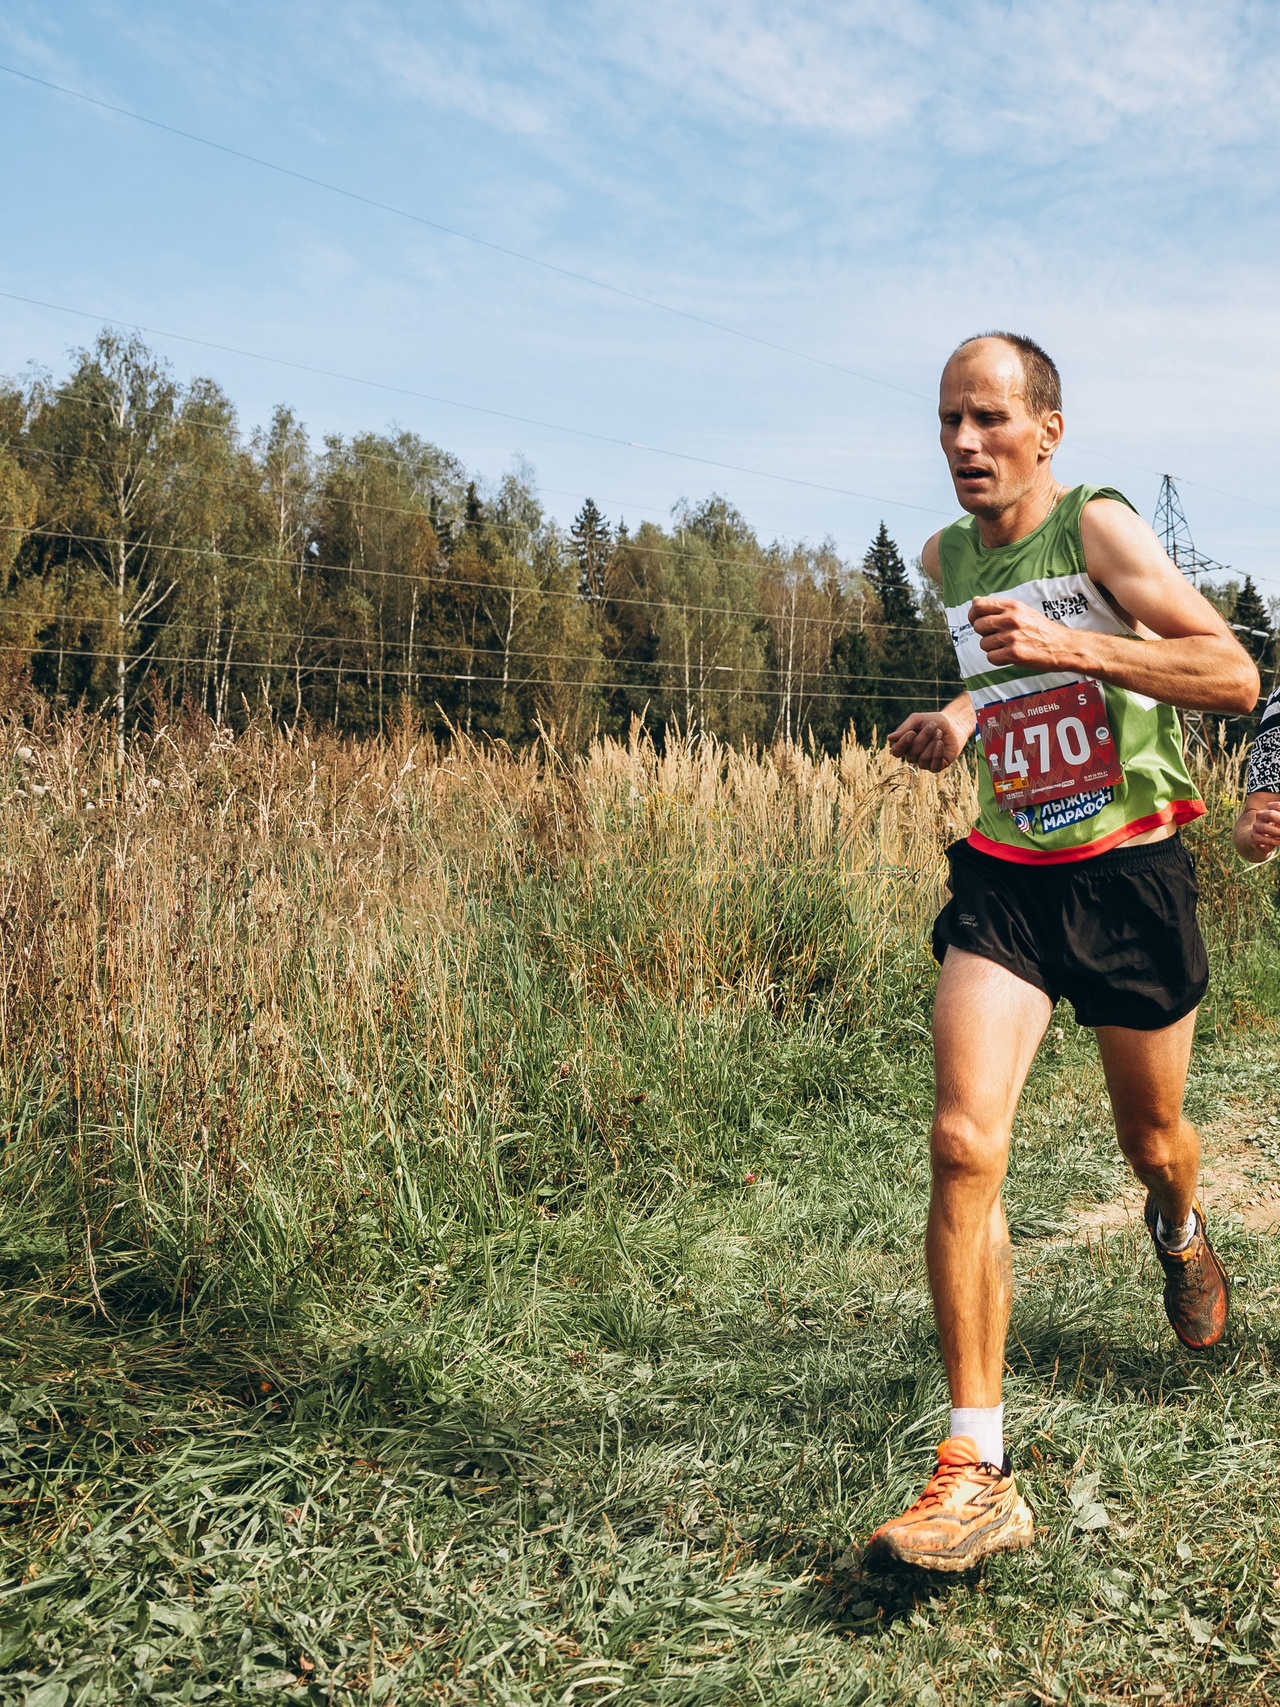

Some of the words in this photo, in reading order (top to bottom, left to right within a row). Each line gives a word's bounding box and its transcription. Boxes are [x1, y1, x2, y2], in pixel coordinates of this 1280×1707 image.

[1042, 592, 1088, 611] RUSSIA
[1027, 703, 1060, 717] ЛИВЕНЬ
[1078, 694, 1087, 705] S
[1004, 716, 1091, 777] 470
[1041, 785, 1110, 817] ЛЫЖНЫ
[1043, 791, 1112, 831] МАРАФОН
